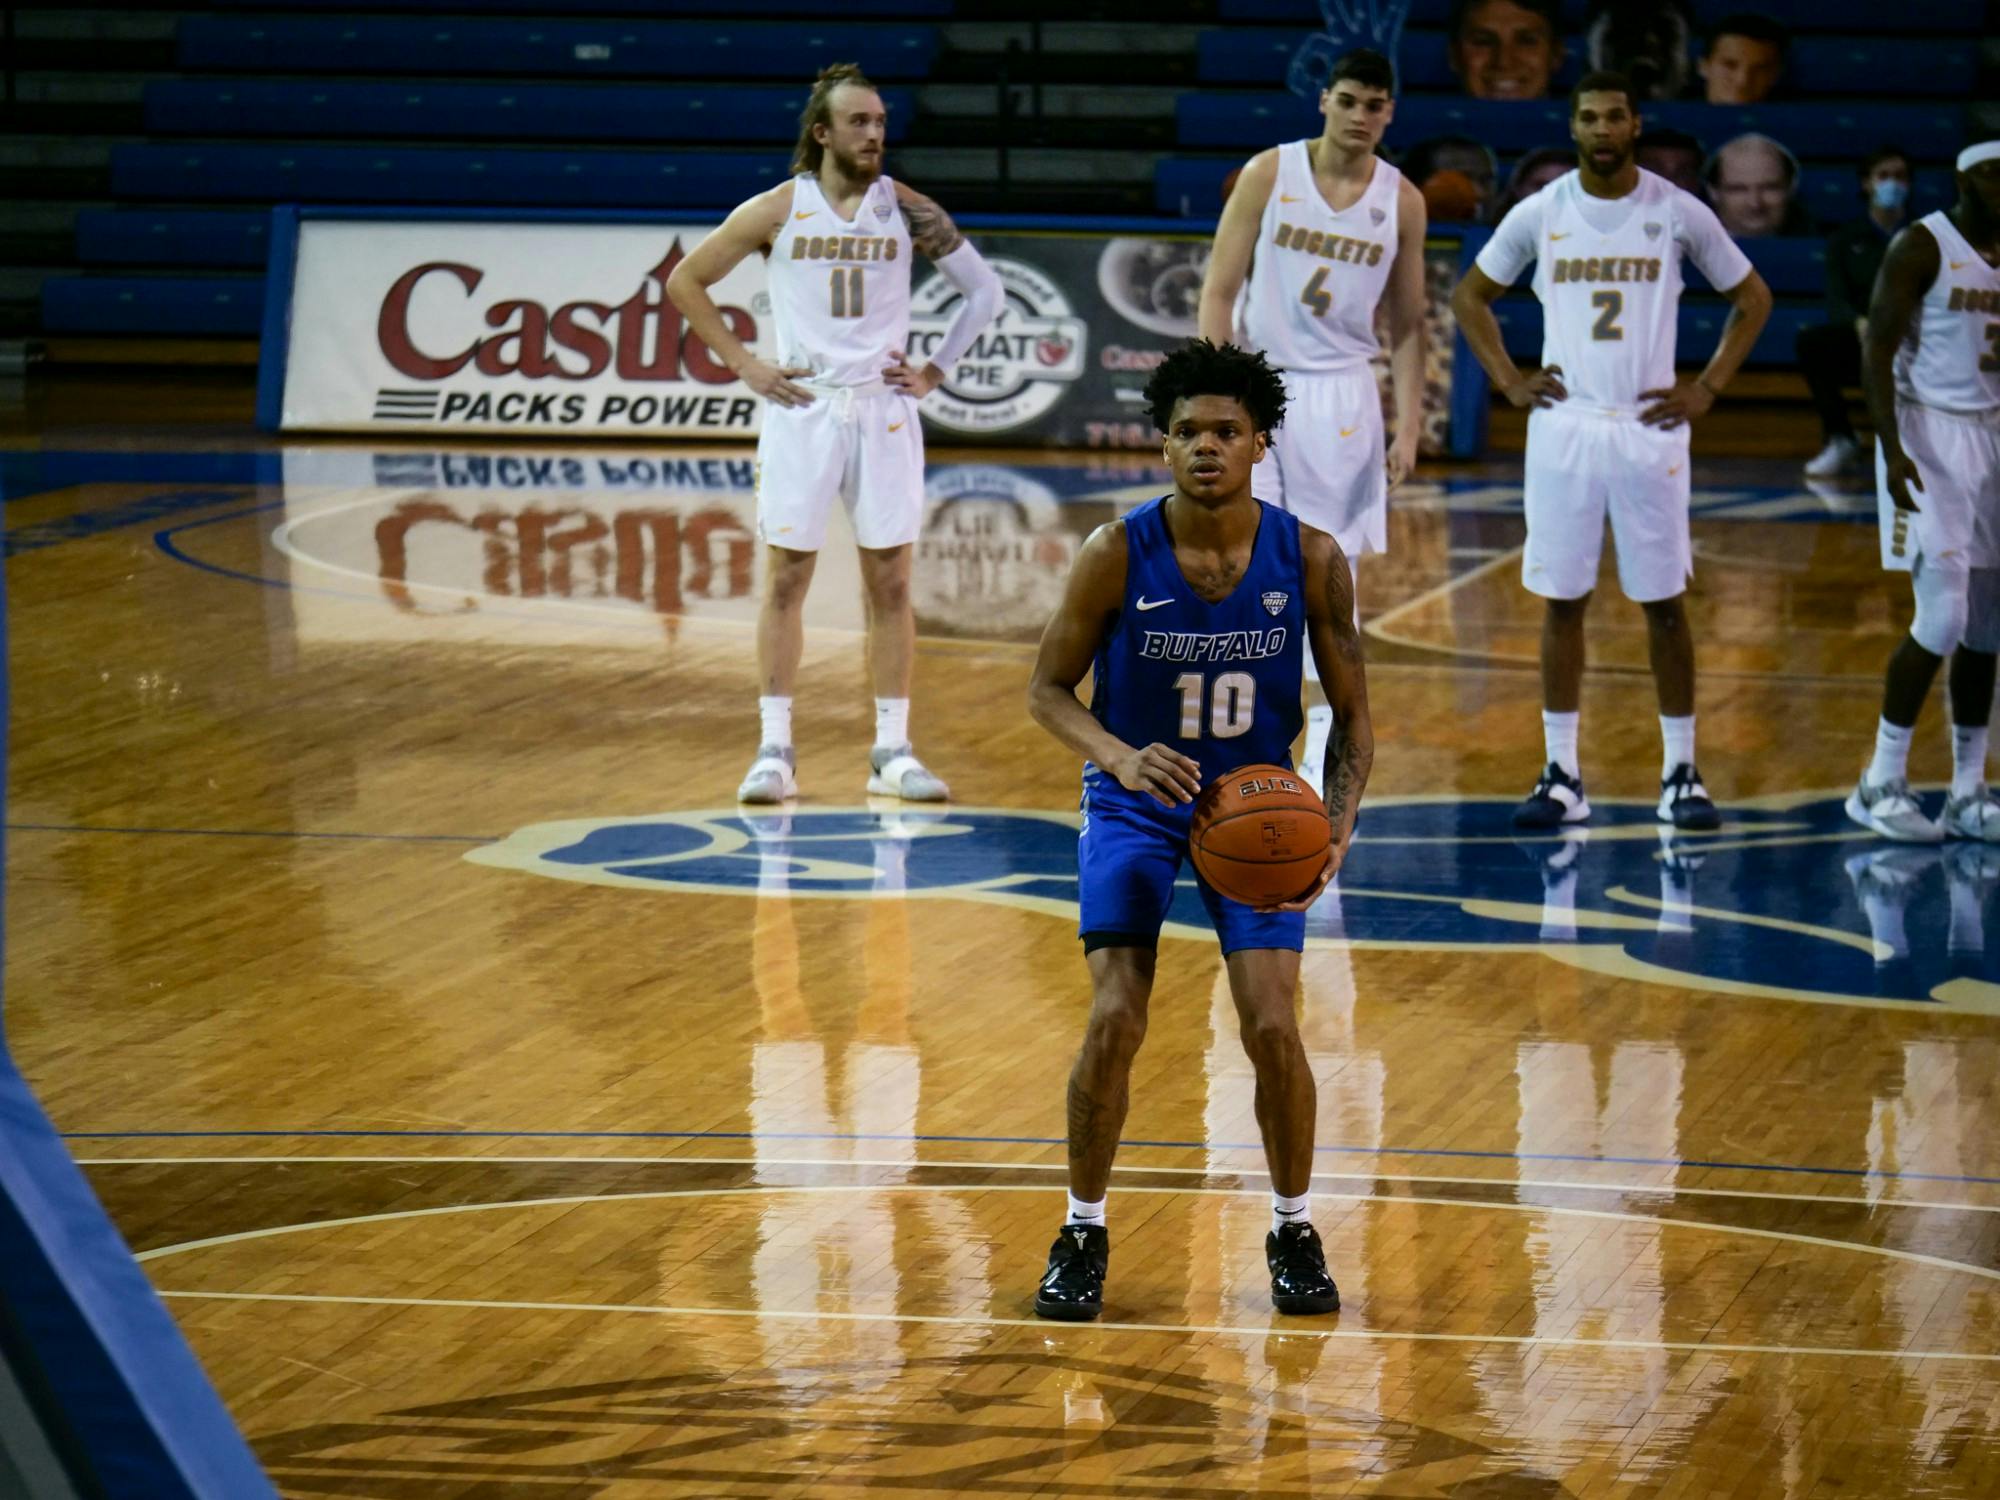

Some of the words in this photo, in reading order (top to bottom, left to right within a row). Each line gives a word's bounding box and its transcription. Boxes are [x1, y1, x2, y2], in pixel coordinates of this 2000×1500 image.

[791, 236, 898, 261] ROCKETS
[1274, 222, 1384, 267] ROCKETS
[830, 267, 864, 318] 11
[1301, 266, 1331, 317] 4
[1552, 257, 1662, 283] ROCKETS
[378, 234, 758, 385] Castle
[1592, 289, 1624, 341] 2
[957, 365, 1002, 395] PIE
[440, 392, 587, 424] PACKS
[599, 396, 758, 427] POWER
[1139, 627, 1286, 662] BUFFALO
[1172, 671, 1256, 740] 10
